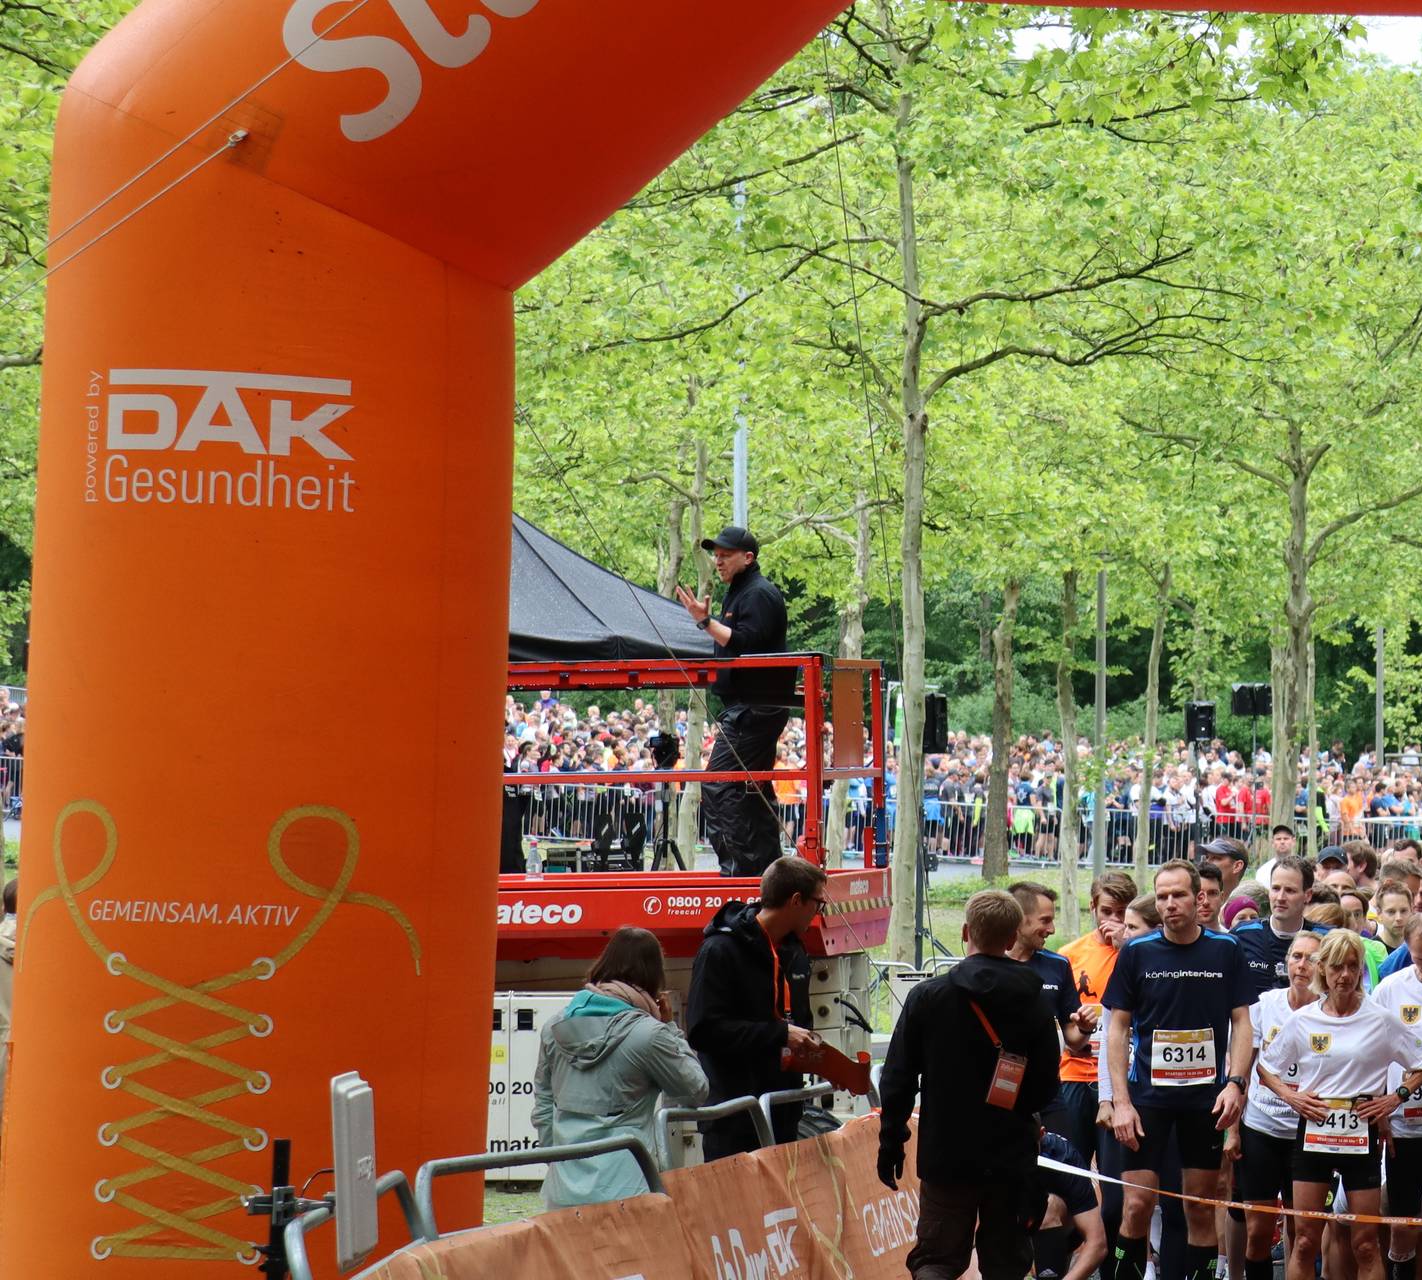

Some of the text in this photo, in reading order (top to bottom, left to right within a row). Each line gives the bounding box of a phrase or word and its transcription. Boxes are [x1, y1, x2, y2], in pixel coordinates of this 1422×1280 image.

[283, 0, 541, 142] St
[107, 368, 355, 461] DAK
[84, 370, 104, 503] powered by
[104, 454, 356, 513] Gesundheit
[89, 899, 300, 927] GEMEINSAM. AKTIV
[497, 900, 583, 925] ateco
[667, 897, 702, 908] 0800
[705, 897, 722, 908] 20
[667, 908, 702, 916] freecall
[1145, 970, 1223, 979] körlinginteriors
[1163, 1046, 1206, 1063] 6314
[512, 1082, 533, 1094] 20
